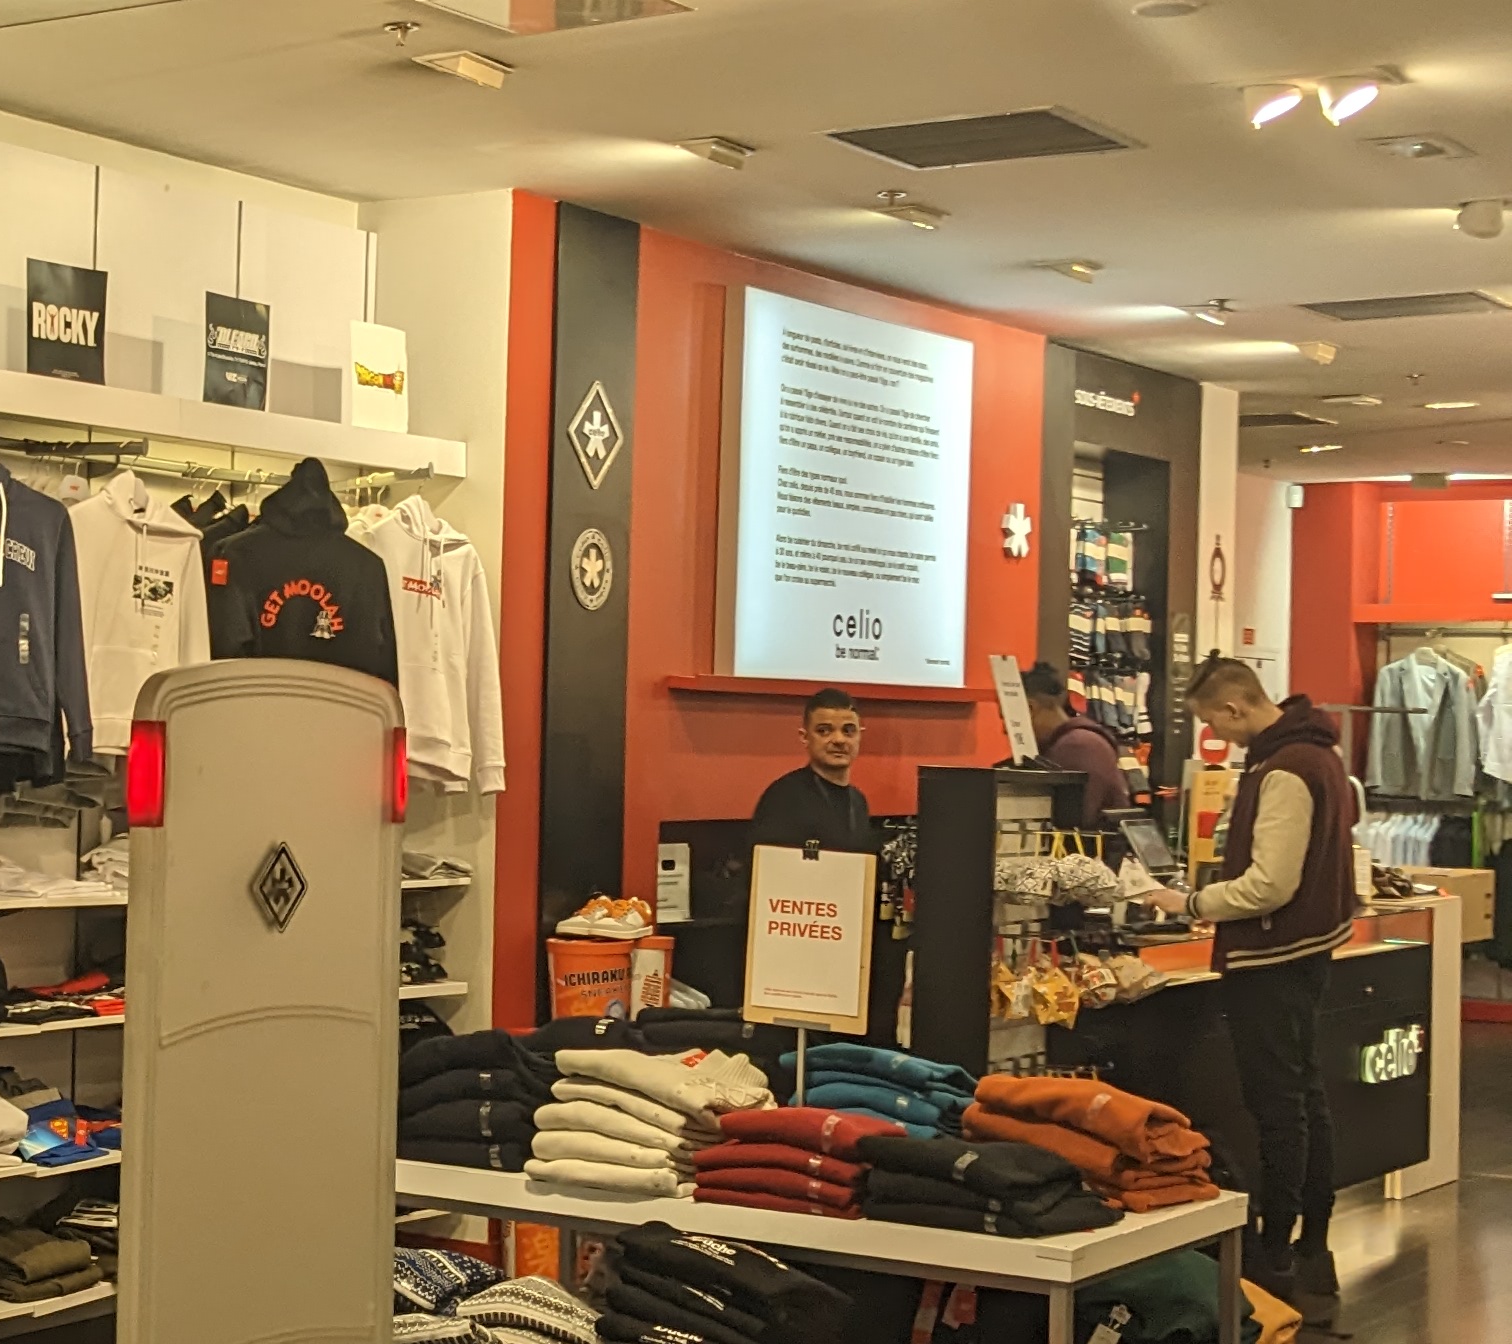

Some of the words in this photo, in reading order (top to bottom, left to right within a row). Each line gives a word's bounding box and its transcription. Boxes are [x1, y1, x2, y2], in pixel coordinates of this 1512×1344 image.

[32, 301, 99, 347] ROCKY
[260, 590, 284, 628] GET
[833, 608, 882, 640] celio
[768, 898, 838, 918] VENTES
[767, 920, 843, 942] PRIVÉES
[564, 968, 625, 987] ICHIRAKU
